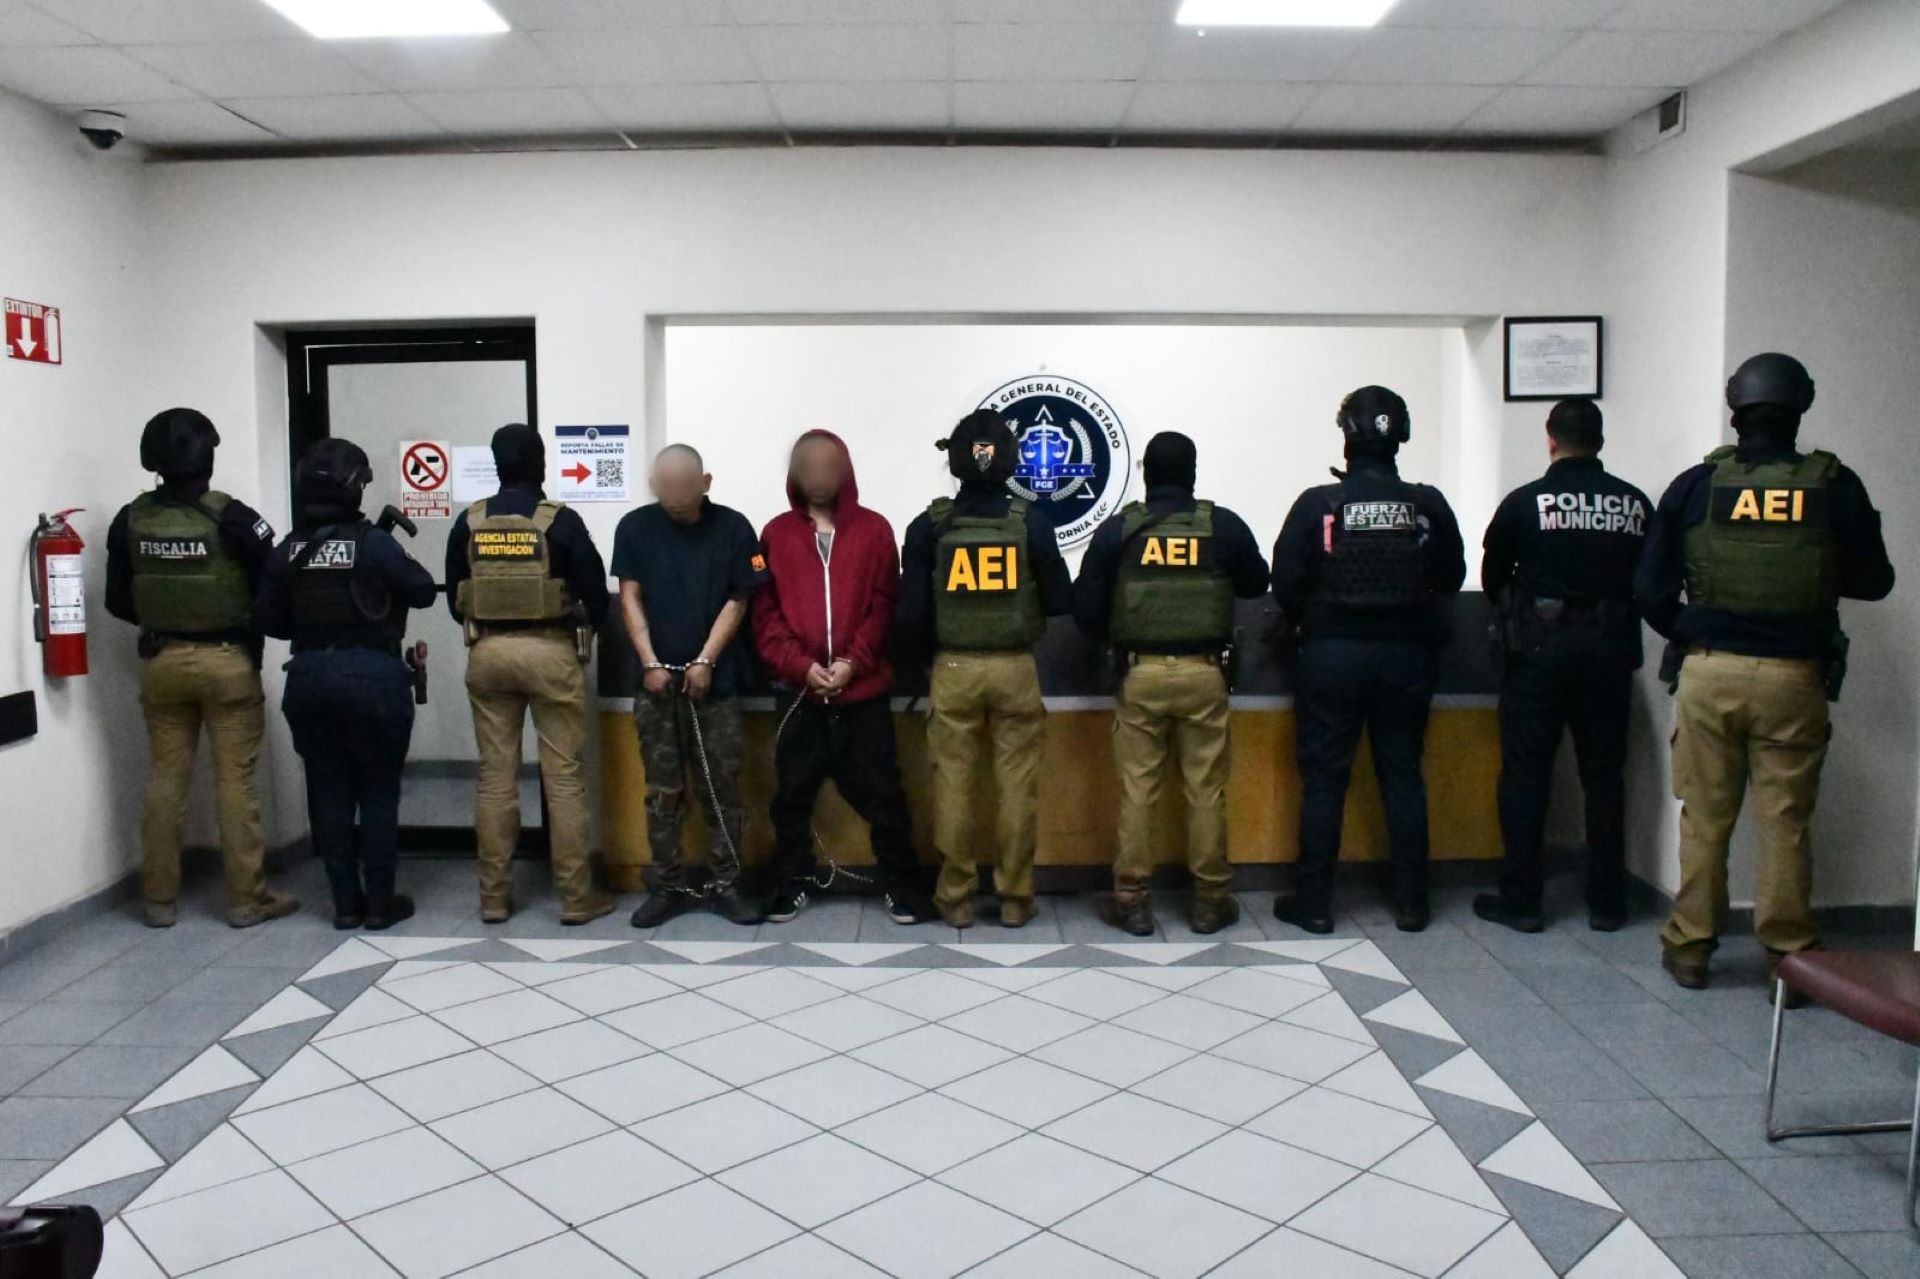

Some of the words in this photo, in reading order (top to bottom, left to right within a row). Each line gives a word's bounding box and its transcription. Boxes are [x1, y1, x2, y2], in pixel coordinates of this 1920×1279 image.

[1001, 383, 1061, 403] GENERAL
[1065, 386, 1088, 404] DEL
[1089, 402, 1121, 449] ESTADO
[1351, 504, 1408, 514] FUERZA
[1730, 488, 1804, 522] AEI
[1346, 514, 1414, 525] ESTATAL
[1539, 511, 1645, 536] MUNICIPAL
[140, 541, 206, 555] FISCALIA
[475, 533, 505, 542] AGENCIA
[506, 532, 538, 542] ESTATAL
[1141, 537, 1198, 566] AEI
[947, 546, 1017, 591] AEI
